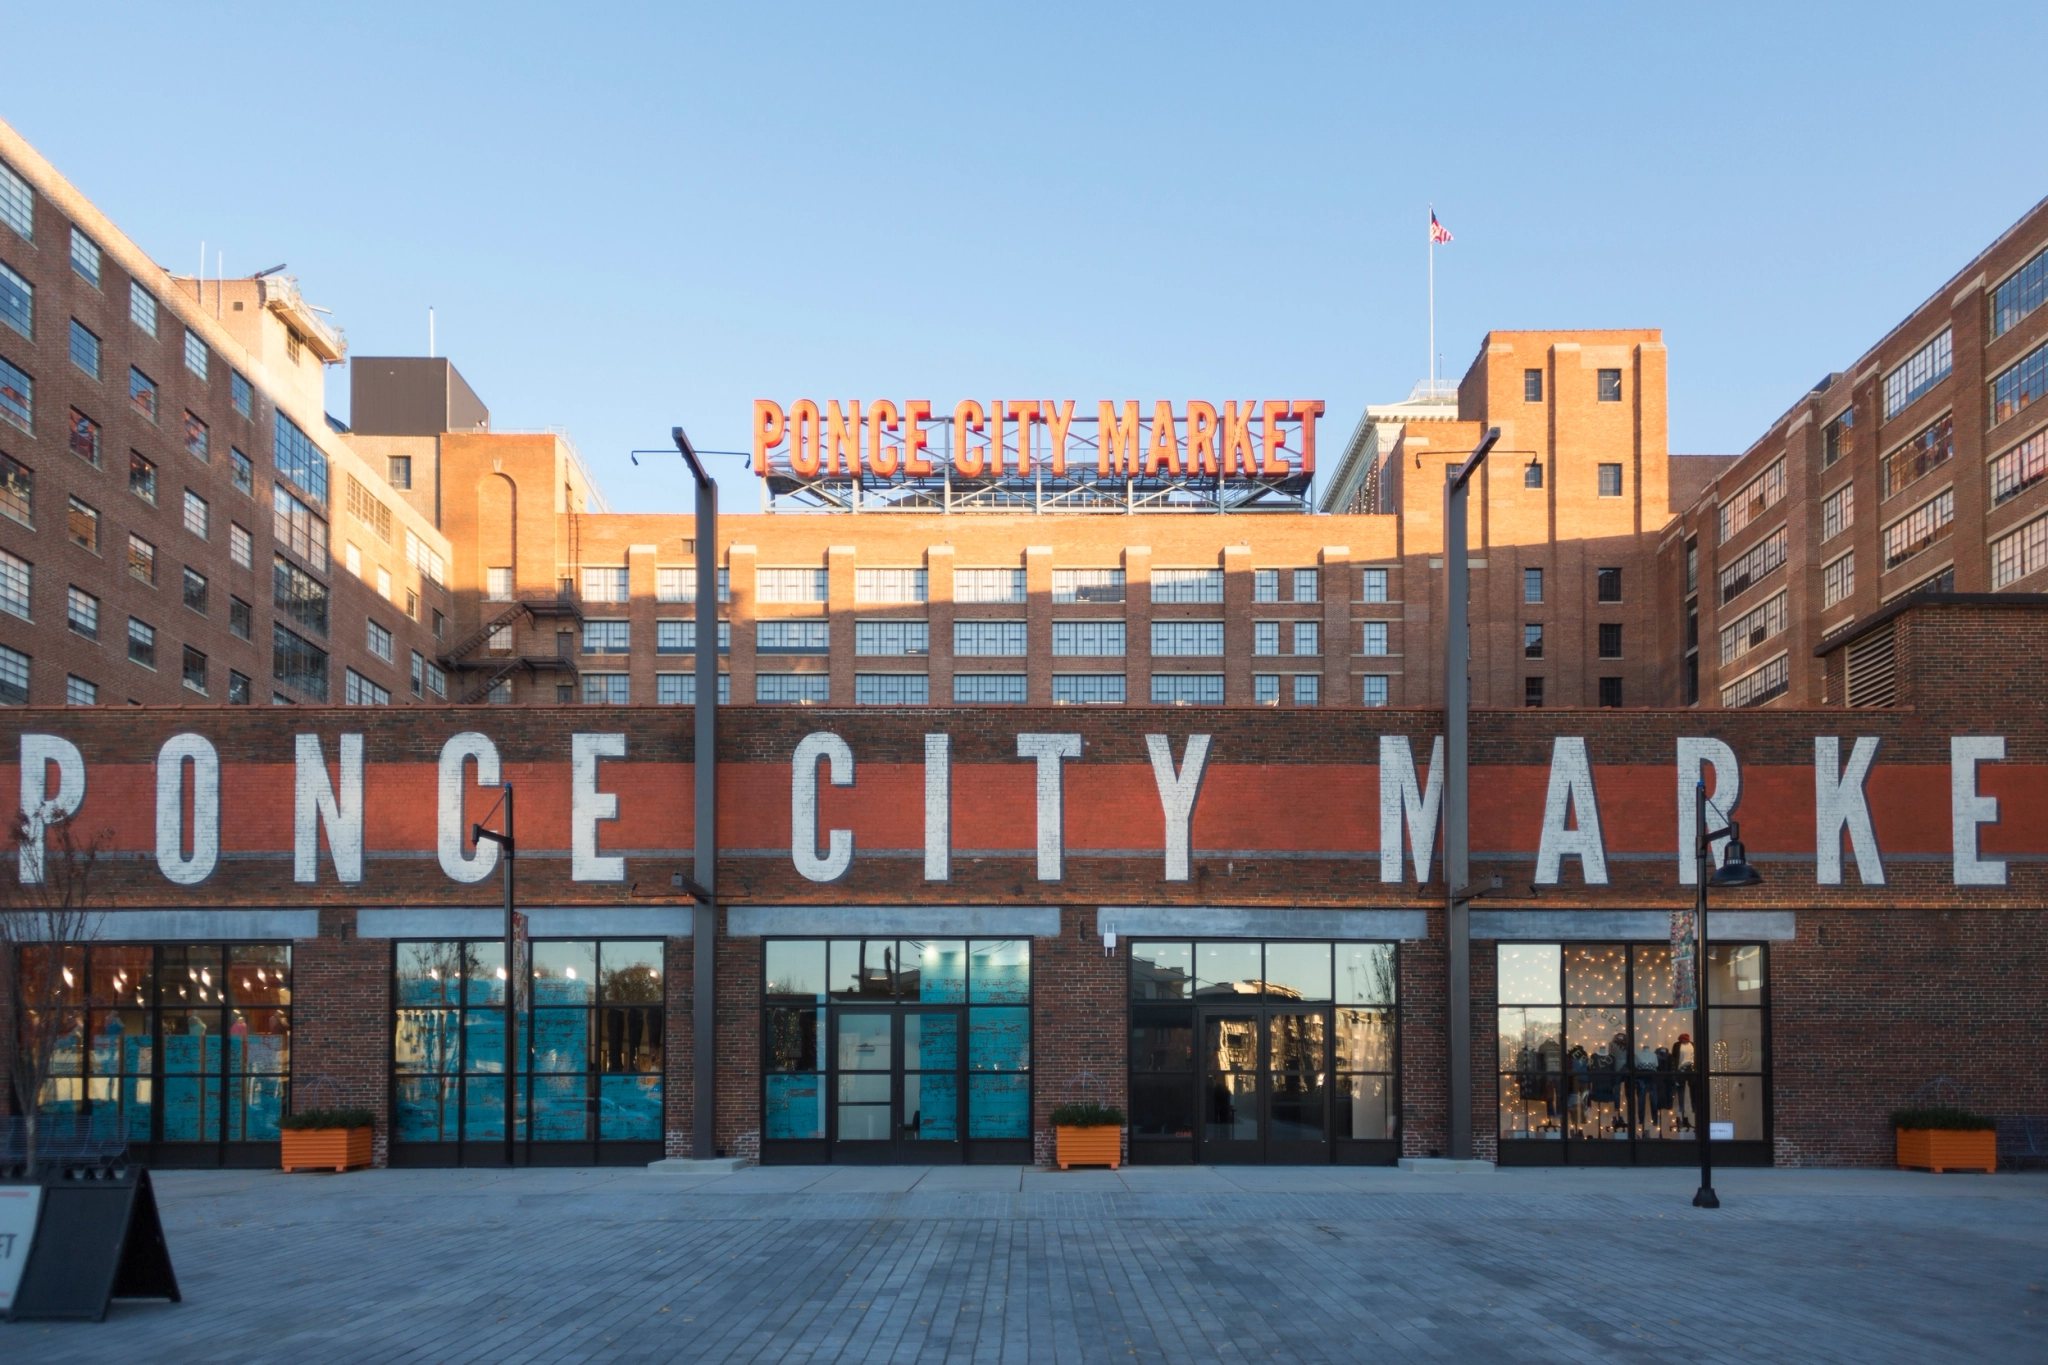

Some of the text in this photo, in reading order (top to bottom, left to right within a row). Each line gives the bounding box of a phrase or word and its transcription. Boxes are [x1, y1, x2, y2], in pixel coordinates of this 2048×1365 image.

[753, 399, 1325, 480] PONCE CITY MARKET
[19, 732, 628, 885] PONCE
[791, 732, 1213, 884] CITY
